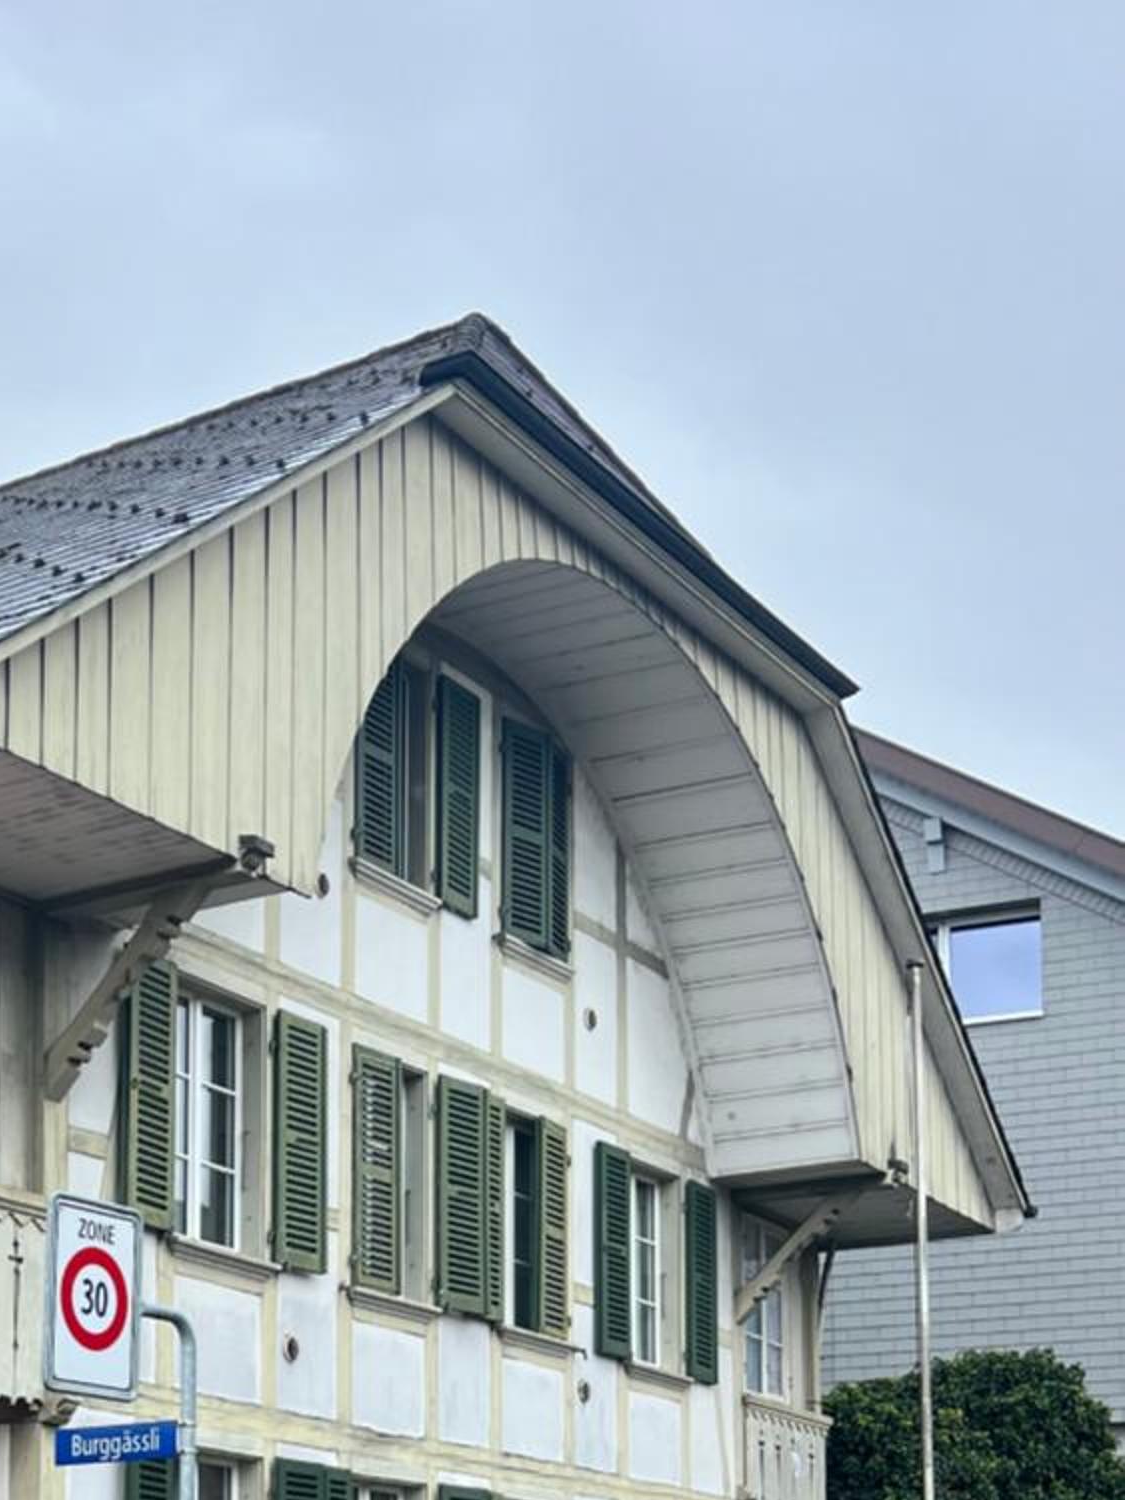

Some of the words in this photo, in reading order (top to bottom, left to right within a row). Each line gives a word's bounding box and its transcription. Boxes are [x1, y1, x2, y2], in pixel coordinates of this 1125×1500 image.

[78, 1217, 115, 1245] ZONE
[80, 1279, 109, 1318] 30
[71, 1427, 160, 1460] Burggässli
